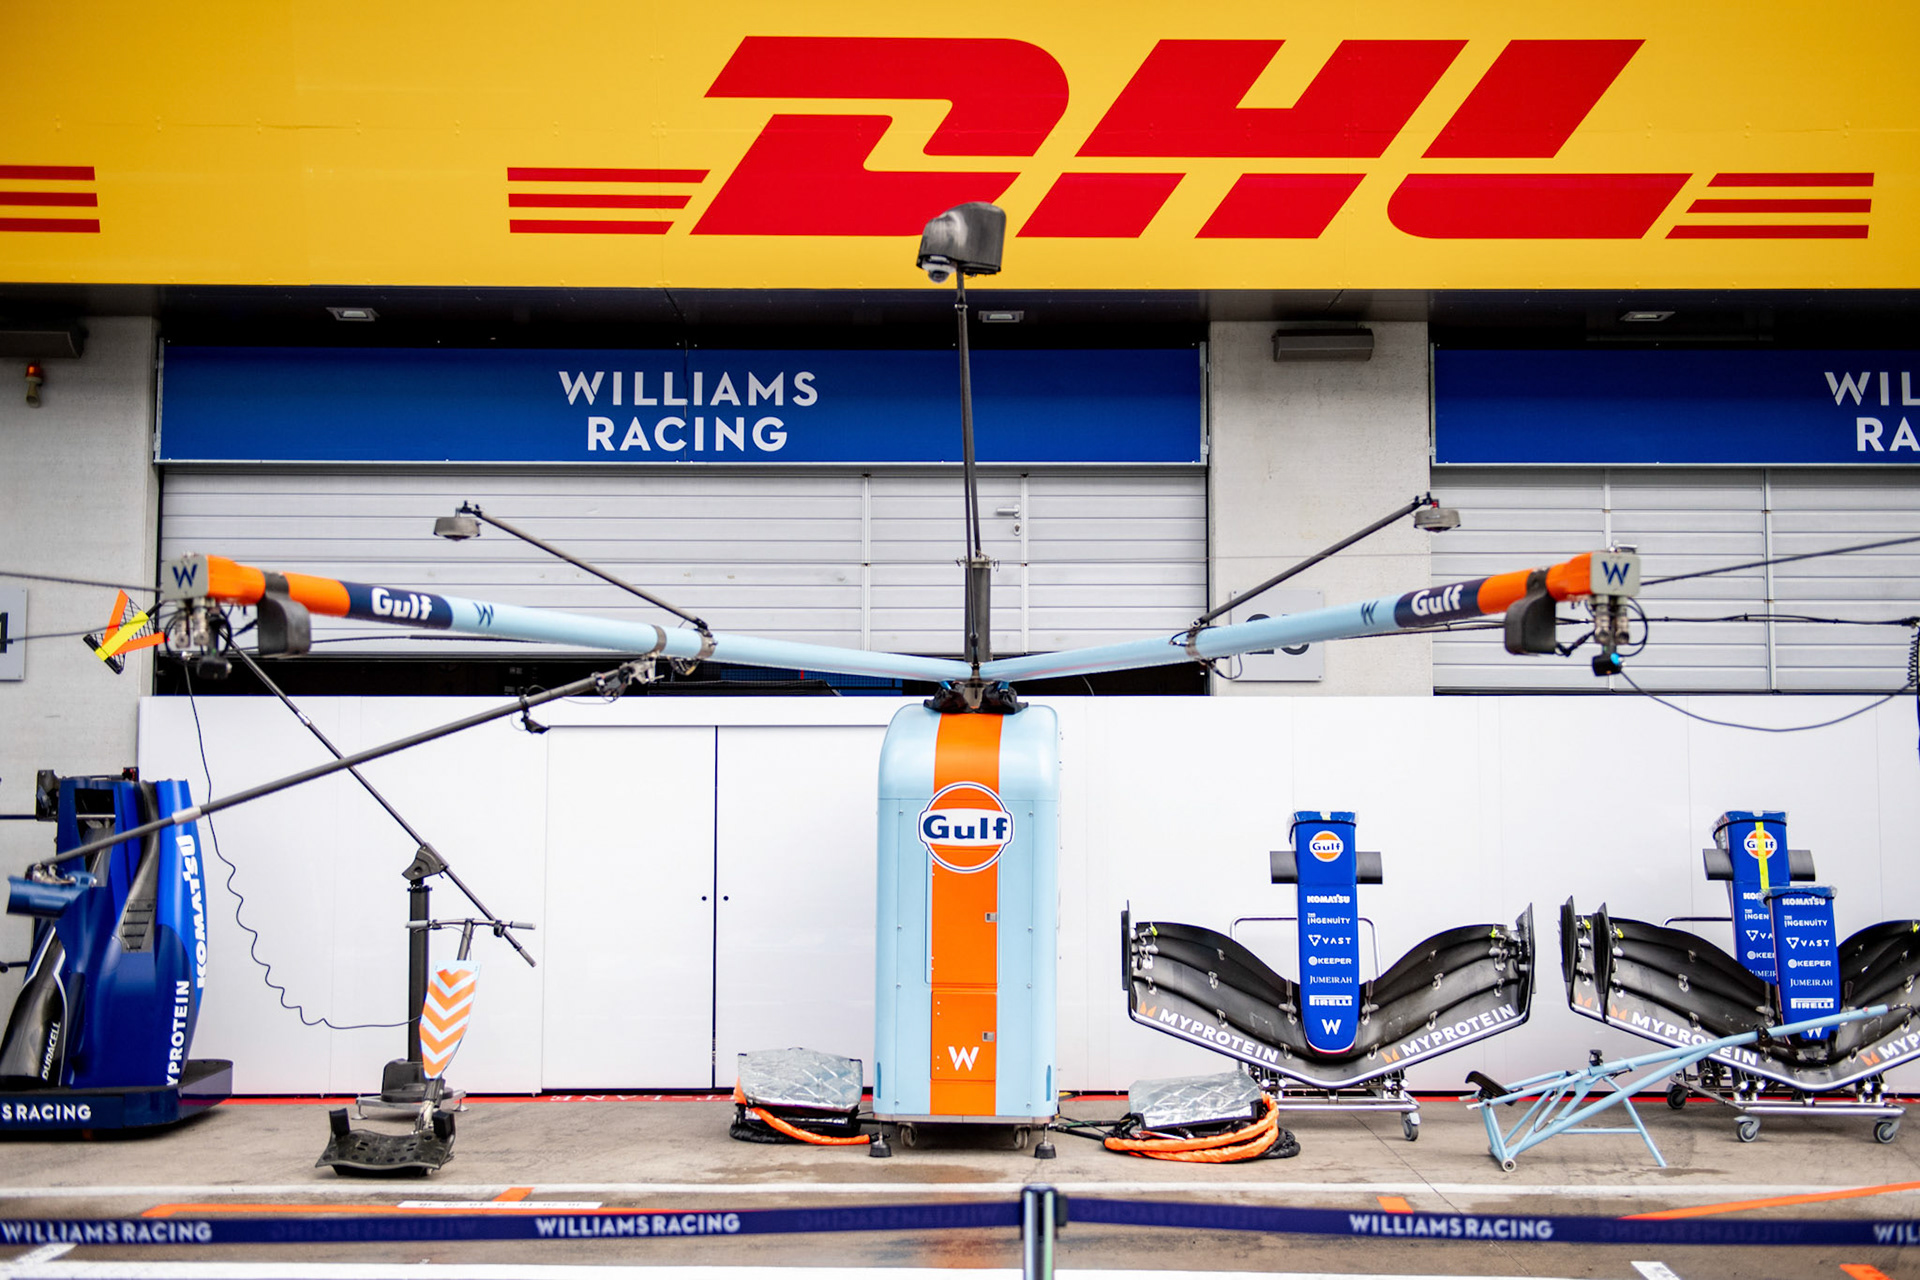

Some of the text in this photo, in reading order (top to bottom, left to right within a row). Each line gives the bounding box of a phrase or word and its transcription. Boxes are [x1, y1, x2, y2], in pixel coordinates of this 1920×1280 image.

[690, 36, 1692, 239] DHL
[559, 371, 818, 407] WILLIAMS
[587, 416, 788, 452] RACING
[172, 563, 198, 589] W
[1602, 561, 1629, 586] W
[371, 586, 432, 621] Gulf
[1411, 584, 1461, 617] Gulf
[922, 814, 1009, 840] Gulf
[1312, 841, 1341, 852] Gulf
[1746, 840, 1774, 849] Glf
[175, 834, 208, 989] KOMATSU
[1306, 894, 1350, 904] KOMATSU
[1782, 896, 1826, 906] KOMATSU
[1322, 937, 1352, 945] VAST
[1800, 939, 1830, 947] VAST
[1317, 957, 1352, 965] KEEPER
[1309, 975, 1352, 985] JUMEIRAH
[1790, 978, 1833, 988] JUMEIRAH
[1309, 995, 1353, 1006] PIRELLI
[1790, 998, 1834, 1009] PIRELLI
[1158, 1008, 1279, 1064] MYPROTEIN
[1321, 1018, 1342, 1035] W
[1399, 1003, 1517, 1058] MYPROTEIN
[1632, 1011, 1758, 1067] MYPROEIN
[41, 1021, 61, 1081] DURACELL
[948, 1045, 980, 1071] W
